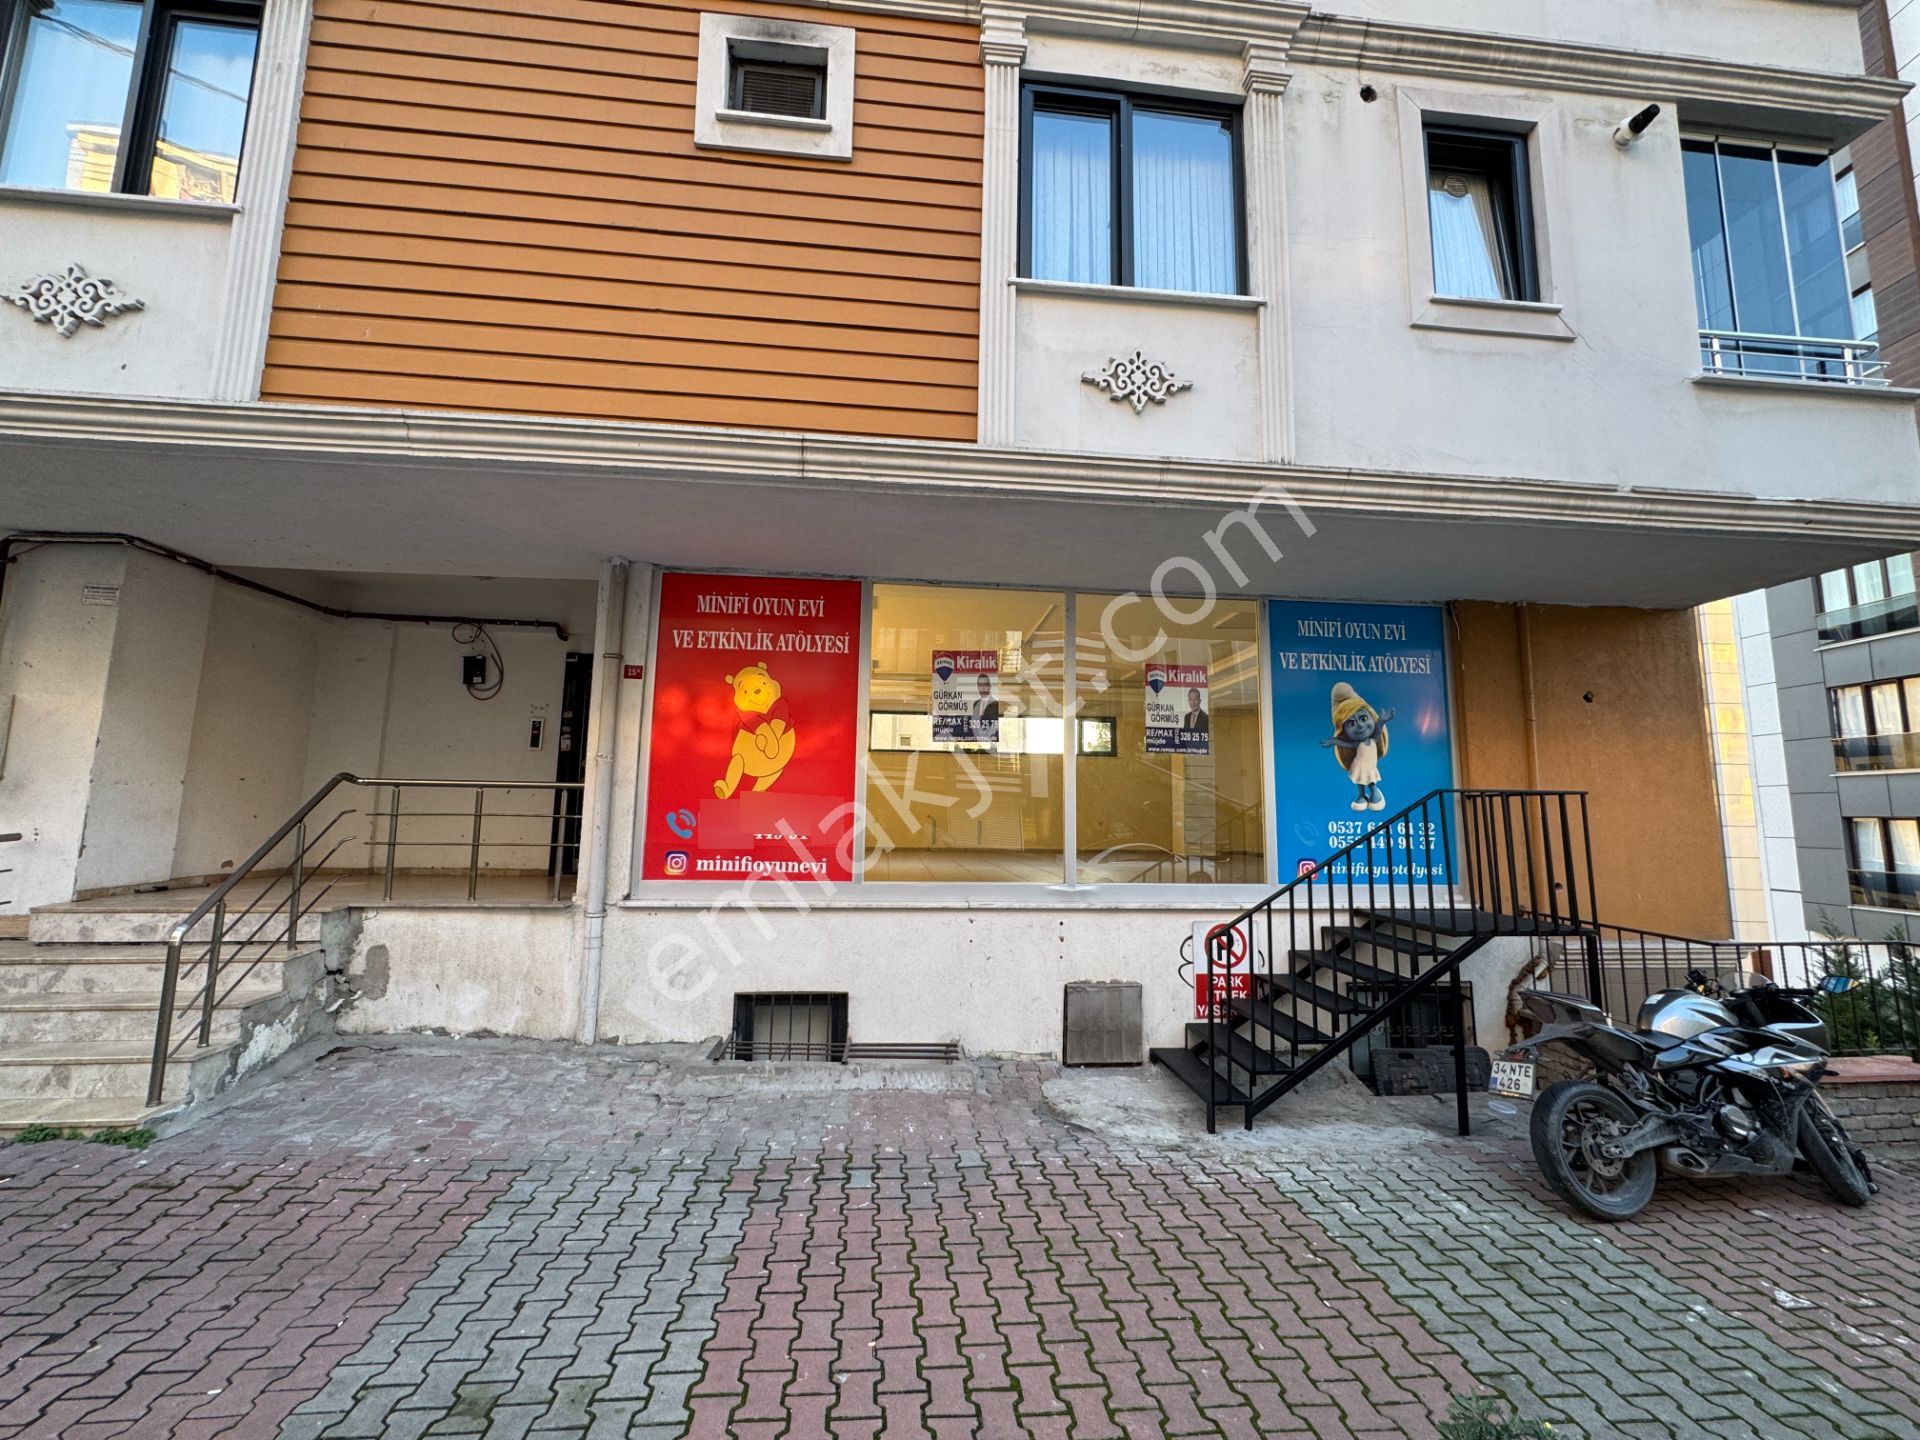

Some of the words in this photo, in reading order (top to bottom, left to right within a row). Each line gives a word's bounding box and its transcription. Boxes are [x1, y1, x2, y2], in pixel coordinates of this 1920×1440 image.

[696, 591, 749, 614] MİNİFİ
[752, 597, 795, 617] OYUN
[798, 596, 825, 618] EVİ
[1297, 617, 1342, 638] MİNİFİ
[1344, 622, 1381, 640] OYUN
[1384, 621, 1407, 641] EVİ
[672, 629, 694, 649] VE
[696, 628, 774, 651] ETKİNLİK
[776, 630, 850, 654] ATÖLYESİ
[956, 655, 997, 669] Kiralık
[1279, 652, 1298, 670] VE
[1300, 650, 1367, 673] ETKİNLİK
[1368, 653, 1431, 674] ATÖLYESİ
[1168, 669, 1207, 683] Kiralık
[933, 691, 963, 700] GÜRKAN
[938, 700, 968, 712] GÖRMÜŞ
[1146, 703, 1174, 712] GÜRKAN
[933, 717, 962, 726] RE/MAX
[1150, 713, 1179, 725] GÖRMÜŞ
[1146, 729, 1174, 738] RE/MAX
[1180, 732, 1192, 741] 320
[1192, 732, 1200, 742] 25
[1201, 732, 1209, 742] 75
[1328, 821, 1363, 834] 0537
[1418, 822, 1435, 835] 32
[696, 855, 827, 876] minifioyunevi
[1494, 1063, 1507, 1074] 34
[1509, 1063, 1532, 1078] NTE
[1499, 1076, 1521, 1091] 426
